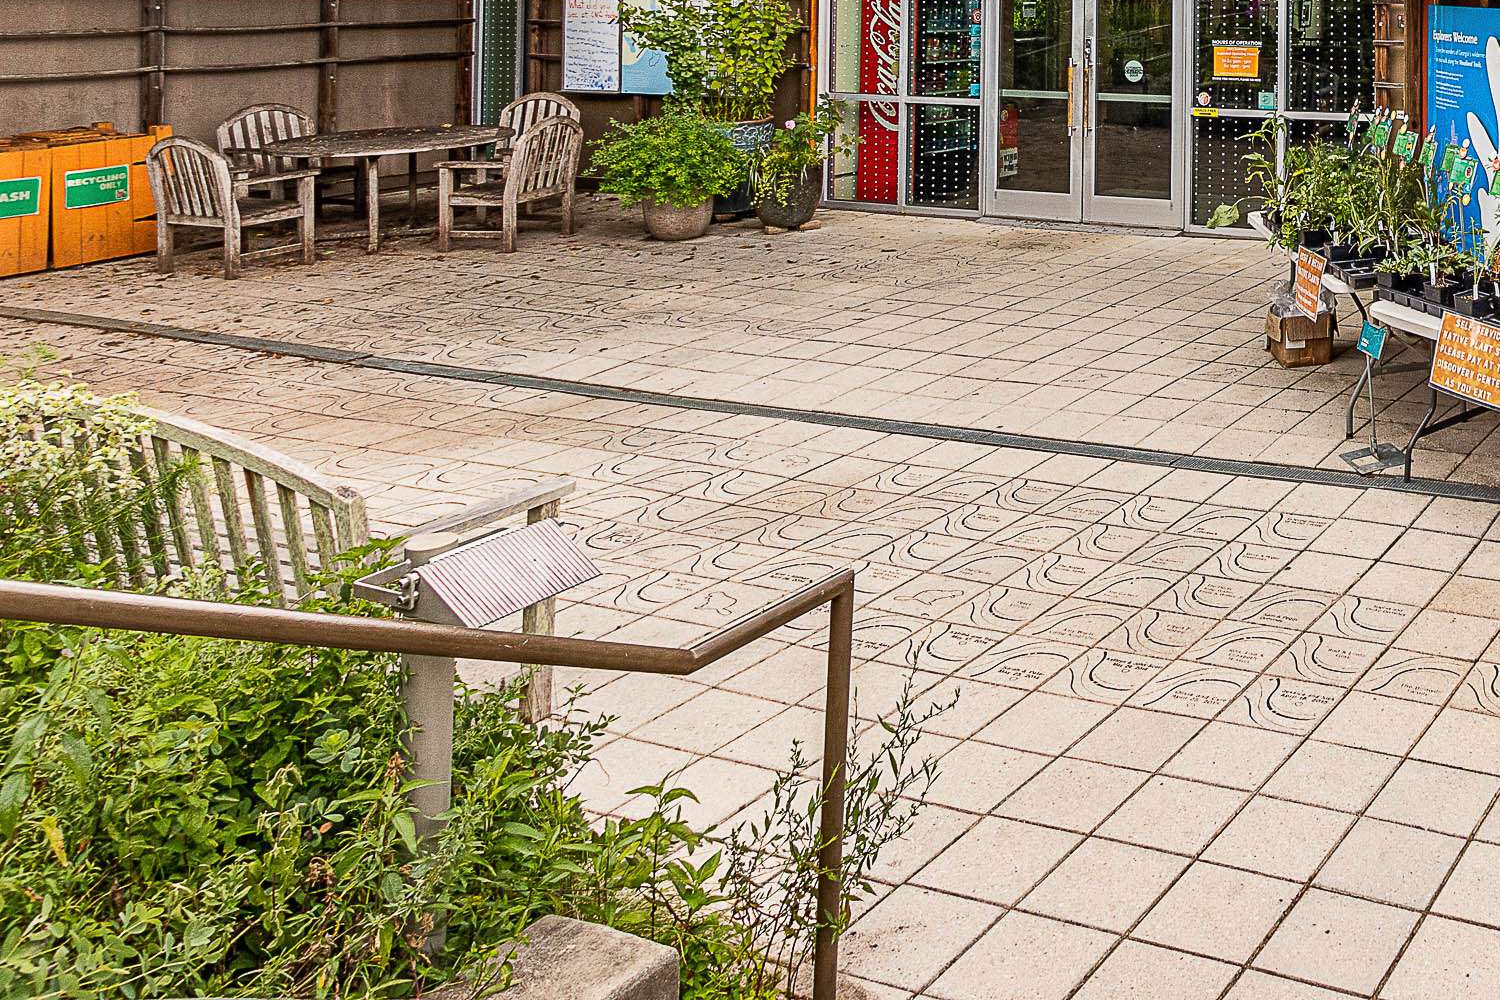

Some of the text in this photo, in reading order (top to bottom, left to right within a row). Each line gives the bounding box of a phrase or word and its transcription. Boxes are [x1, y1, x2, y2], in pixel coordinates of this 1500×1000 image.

[1452, 31, 1478, 44] Welcome
[67, 172, 127, 191] RECYCLING ONLY
[1456, 318, 1472, 331] SELF
[1442, 330, 1468, 344] NATIVE
[1470, 338, 1493, 354] PLANT
[1440, 345, 1465, 360] PLEASE
[1467, 352, 1482, 365] PAY
[1483, 360, 1494, 370] AT
[1438, 359, 1475, 378] DISCOVERY
[1445, 377, 1492, 400] AS YOU EXIT
